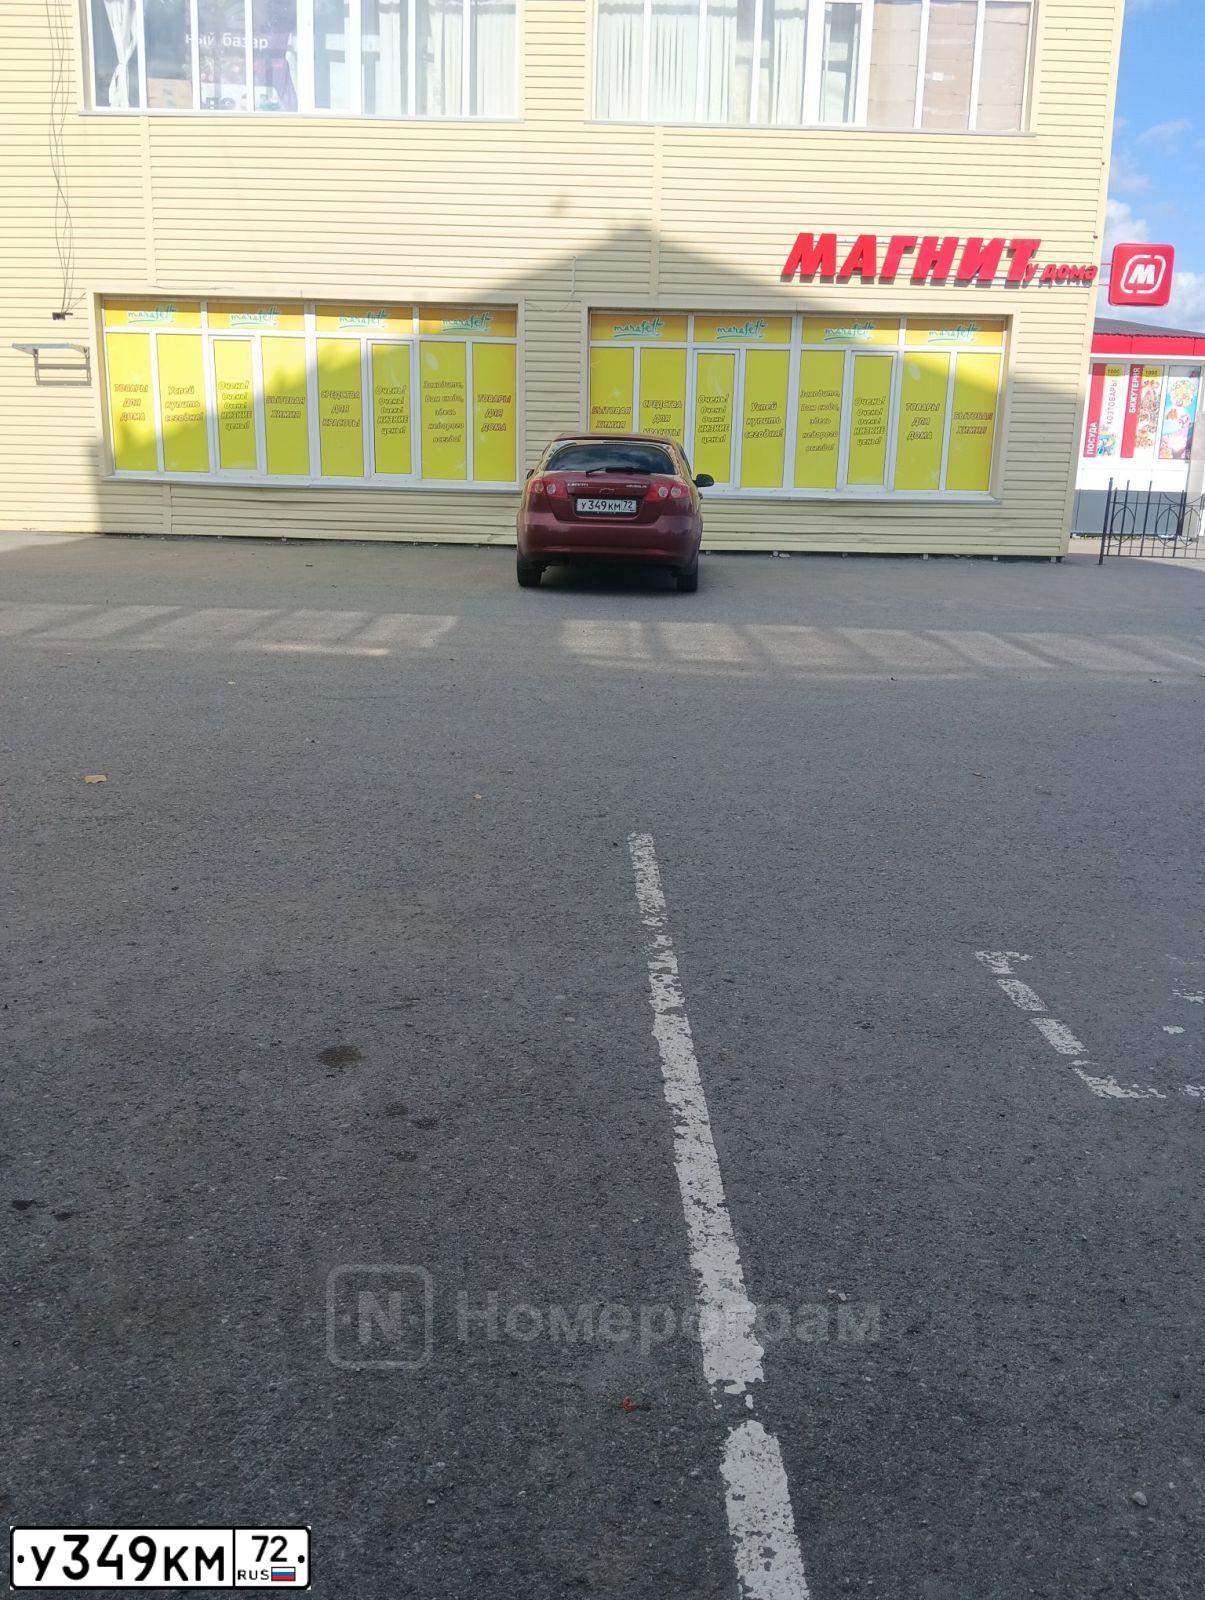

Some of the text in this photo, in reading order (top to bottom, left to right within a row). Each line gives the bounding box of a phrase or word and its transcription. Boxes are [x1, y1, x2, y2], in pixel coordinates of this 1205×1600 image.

[783, 233, 1041, 281] МАГНИТ
[1041, 264, 1098, 283] дома
[114, 384, 148, 393] ТОВАРЫ
[168, 386, 195, 395] Успей
[376, 385, 406, 395] Очень!
[1129, 367, 1140, 413] БИЖУТЕРИЯ
[123, 398, 141, 407] ДЛЯ
[478, 395, 511, 403] ТОВАРЫ
[697, 394, 729, 404] Очень!
[854, 397, 886, 407] Очень!
[1106, 380, 1117, 425] ХОЗТОВАРЫ
[642, 400, 682, 409] СРЕДСТВА
[751, 402, 777, 411] Успей
[905, 403, 940, 411] ТОВАРЫ
[271, 410, 301, 418] ХИМИЯ
[331, 405, 350, 414] ДЛЯ
[484, 409, 503, 418] ДЛЯ
[591, 406, 632, 414] БЫТОВАЯ
[120, 412, 146, 421] ДОМА
[221, 411, 252, 419] НИЗКИЕ
[652, 415, 670, 423] ДЛЯ
[321, 419, 361, 427] КРАСОТЫ
[377, 416, 408, 424] НИЗКИЕ
[746, 417, 781, 426] купить
[911, 417, 930, 426] ДЛЯ
[482, 423, 506, 432] ДОМА
[595, 421, 626, 429] ХИМИЯ
[698, 424, 730, 433] НИЗКИЕ
[381, 426, 406, 435] цены!
[744, 429, 784, 439] сегодня!
[853, 427, 885, 435] НИЗКИЕ
[956, 426, 987, 434] ХИМИЯ
[701, 435, 726, 444] цены!
[907, 431, 932, 441] ДОМА
[1087, 422, 1098, 455] ПОСУДА
[856, 437, 882, 446] цены!
